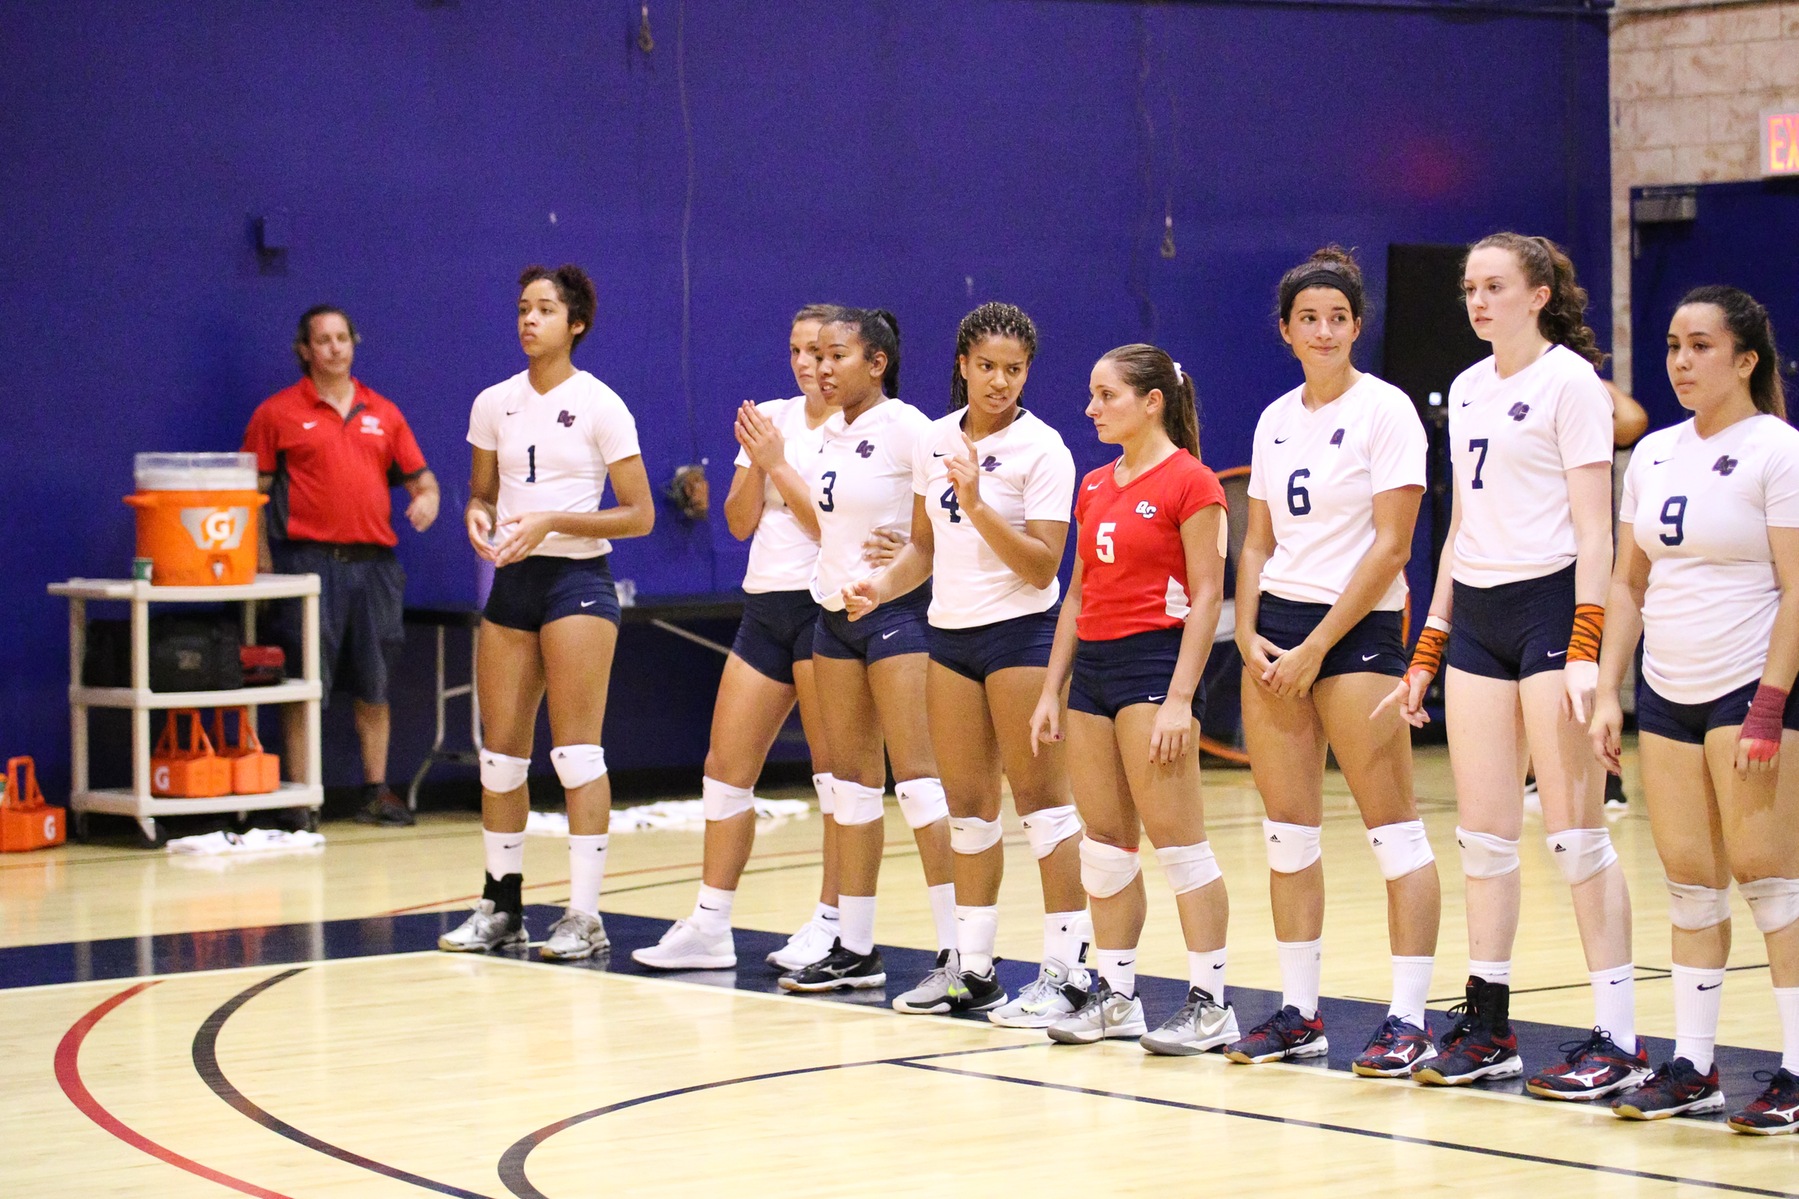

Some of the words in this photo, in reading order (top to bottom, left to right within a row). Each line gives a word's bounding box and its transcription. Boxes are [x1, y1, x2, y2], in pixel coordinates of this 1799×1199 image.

[526, 445, 536, 482] 1
[1469, 438, 1488, 489] 7
[819, 471, 836, 512] 3
[940, 485, 961, 523] 4
[1287, 468, 1311, 516] 6
[206, 511, 230, 540] G
[1659, 495, 1688, 546] 9
[1096, 522, 1117, 564] 5
[155, 766, 170, 791] G
[45, 815, 56, 840] G
